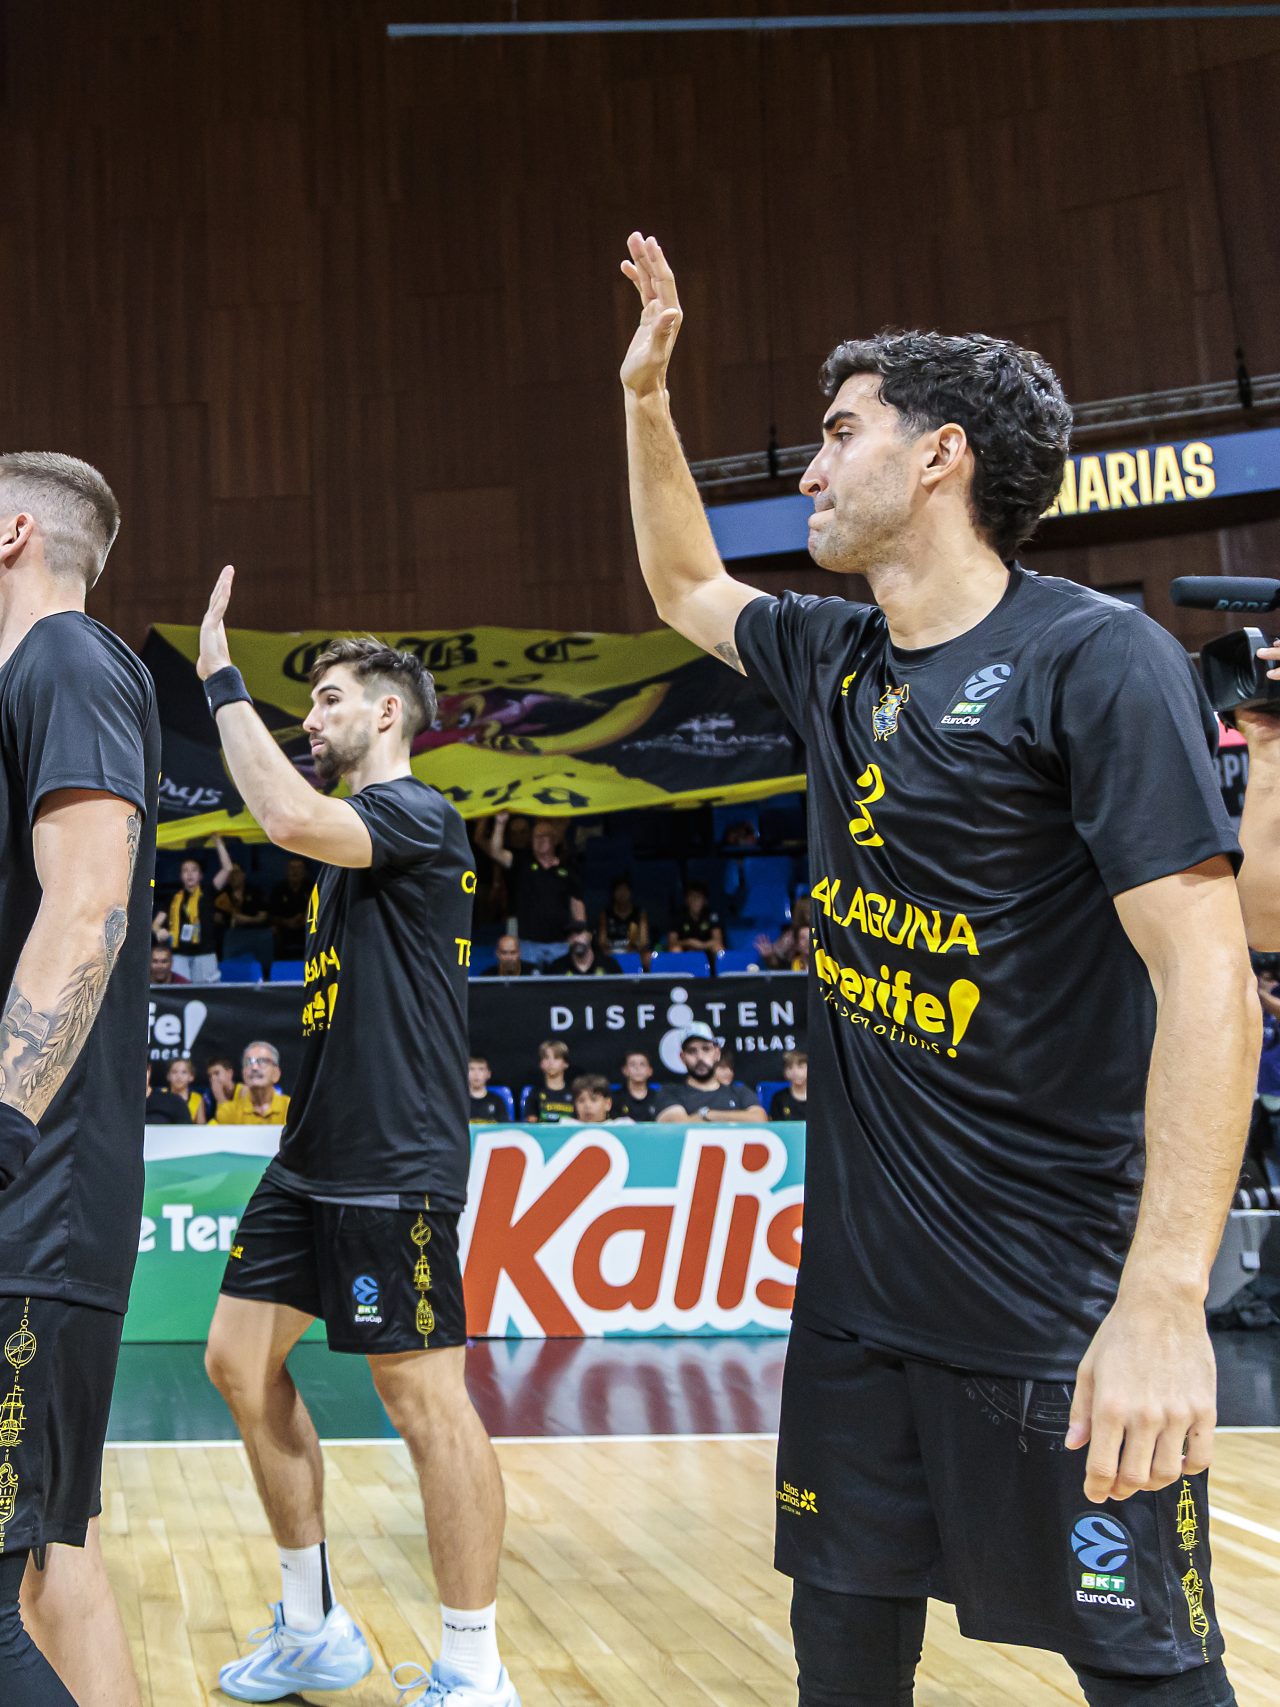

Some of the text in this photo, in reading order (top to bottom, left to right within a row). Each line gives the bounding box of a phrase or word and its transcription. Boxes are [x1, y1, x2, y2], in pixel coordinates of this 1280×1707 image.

[1048, 441, 1216, 518] NARIAS
[941, 715, 981, 726] EuroCup
[735, 1035, 796, 1052] ISLAS
[462, 1142, 804, 1337] Kalis
[1081, 1574, 1124, 1590] BKT
[1075, 1590, 1136, 1609] EuroCup
